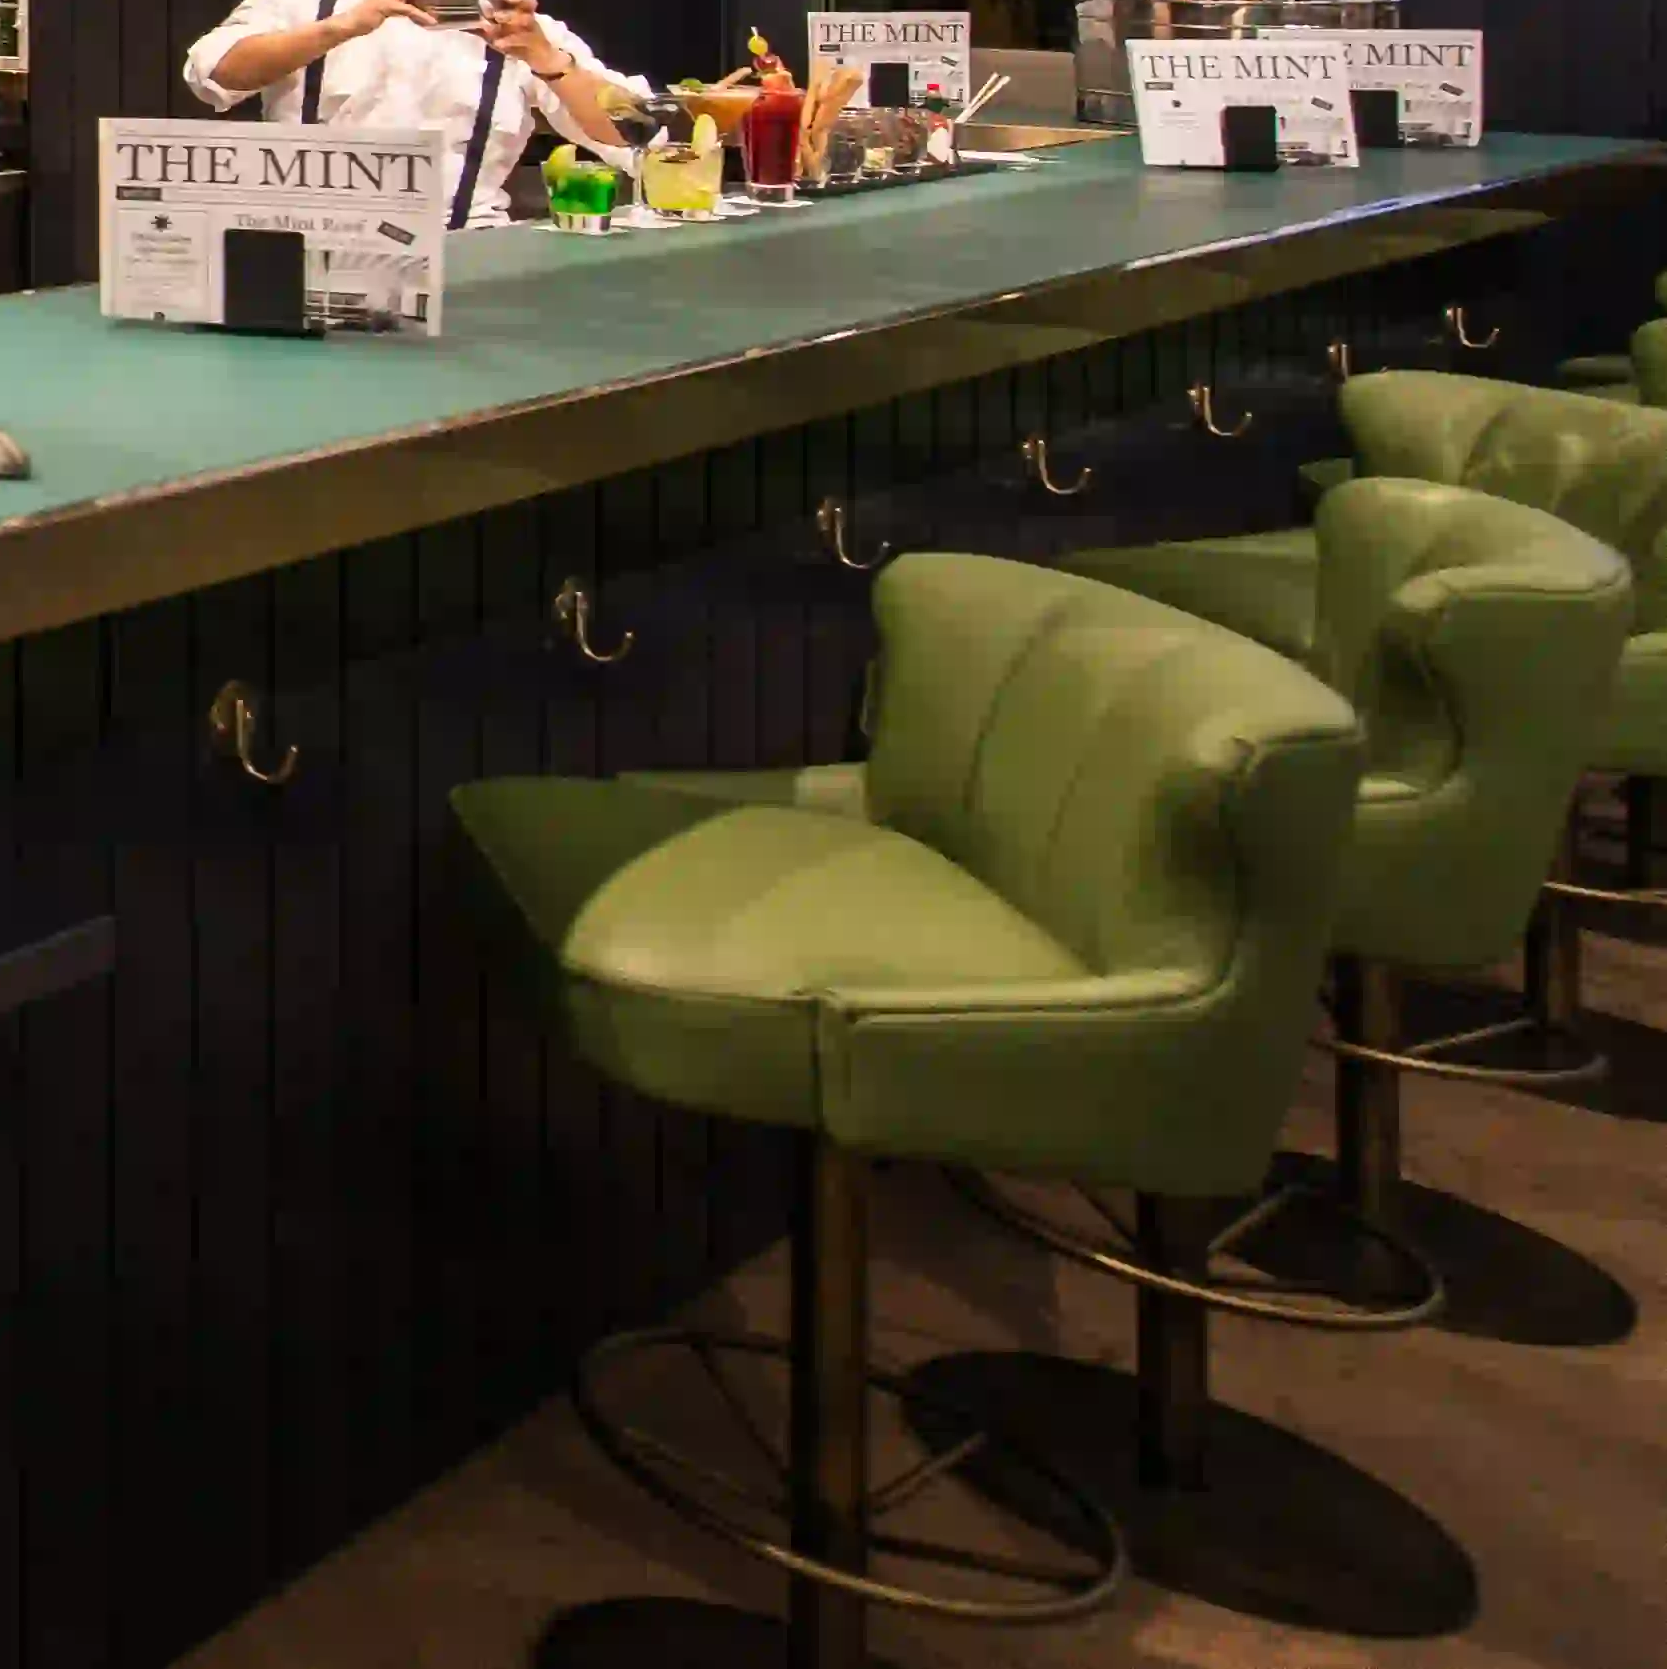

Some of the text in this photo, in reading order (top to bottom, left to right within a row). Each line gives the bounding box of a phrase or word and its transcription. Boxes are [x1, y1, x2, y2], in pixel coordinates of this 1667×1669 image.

[820, 23, 965, 44] THE MINT
[1142, 55, 1336, 80] THE MINT
[1367, 43, 1475, 69] MINT
[117, 143, 432, 194] THE MINT
